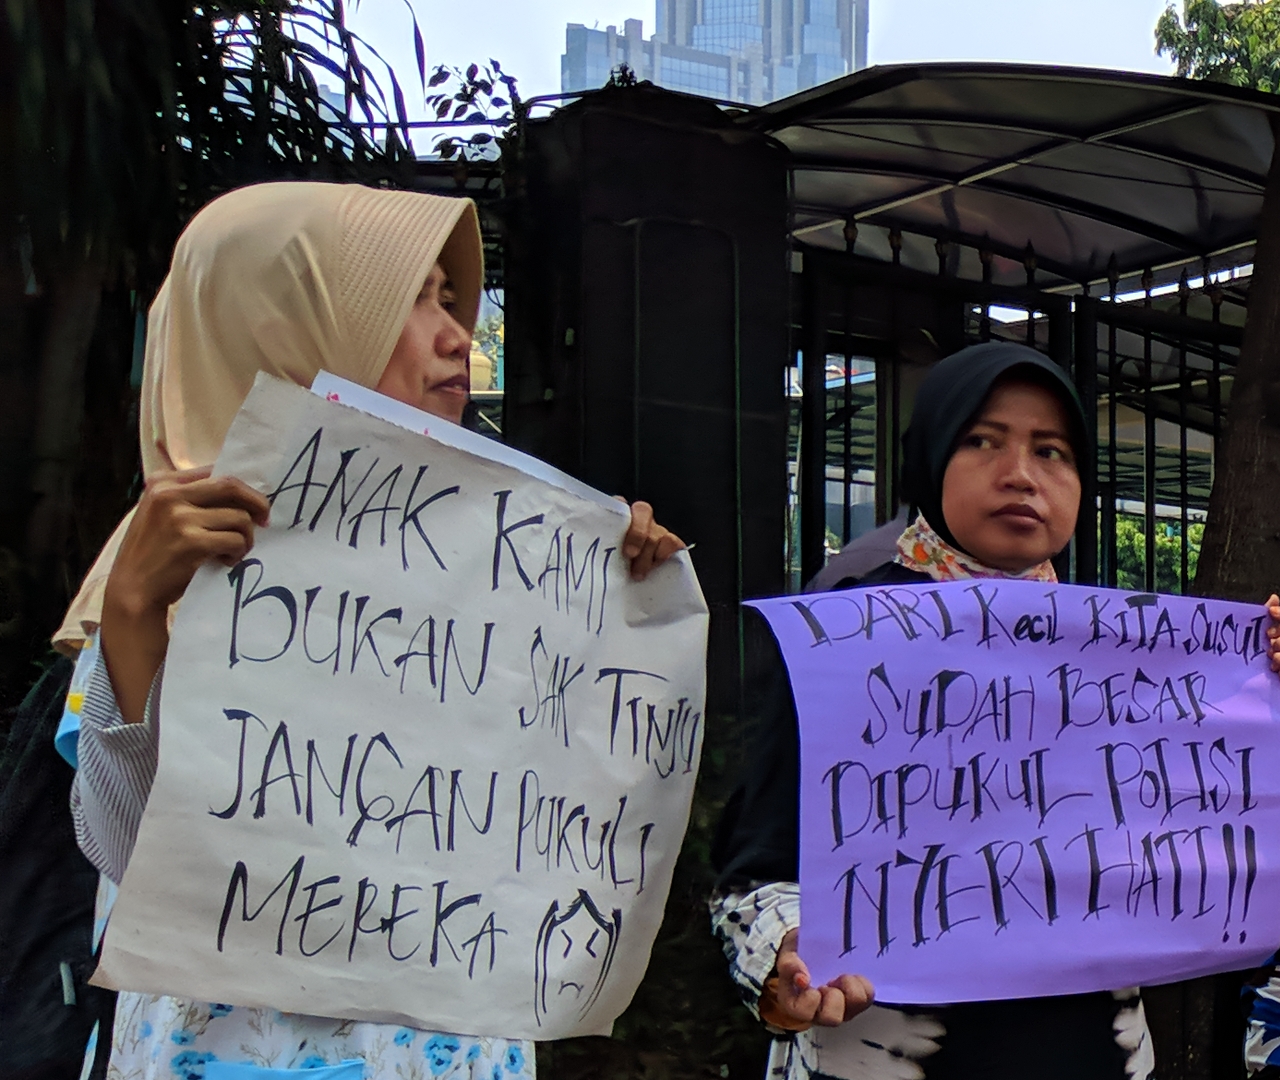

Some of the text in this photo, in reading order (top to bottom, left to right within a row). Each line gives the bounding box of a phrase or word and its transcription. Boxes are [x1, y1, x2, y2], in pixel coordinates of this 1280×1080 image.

[267, 428, 618, 637] ANAK KAMI
[227, 558, 701, 779] BUKAN SAK TINJU
[787, 590, 965, 649] DARI
[1080, 593, 1180, 653] KITA
[1047, 663, 1223, 741] BESAR
[208, 708, 652, 893] JANGAN PUKULI
[821, 737, 1258, 852] DIPUKUL POLISI
[217, 855, 508, 979] MEREKA
[833, 836, 1058, 958] NYERI
